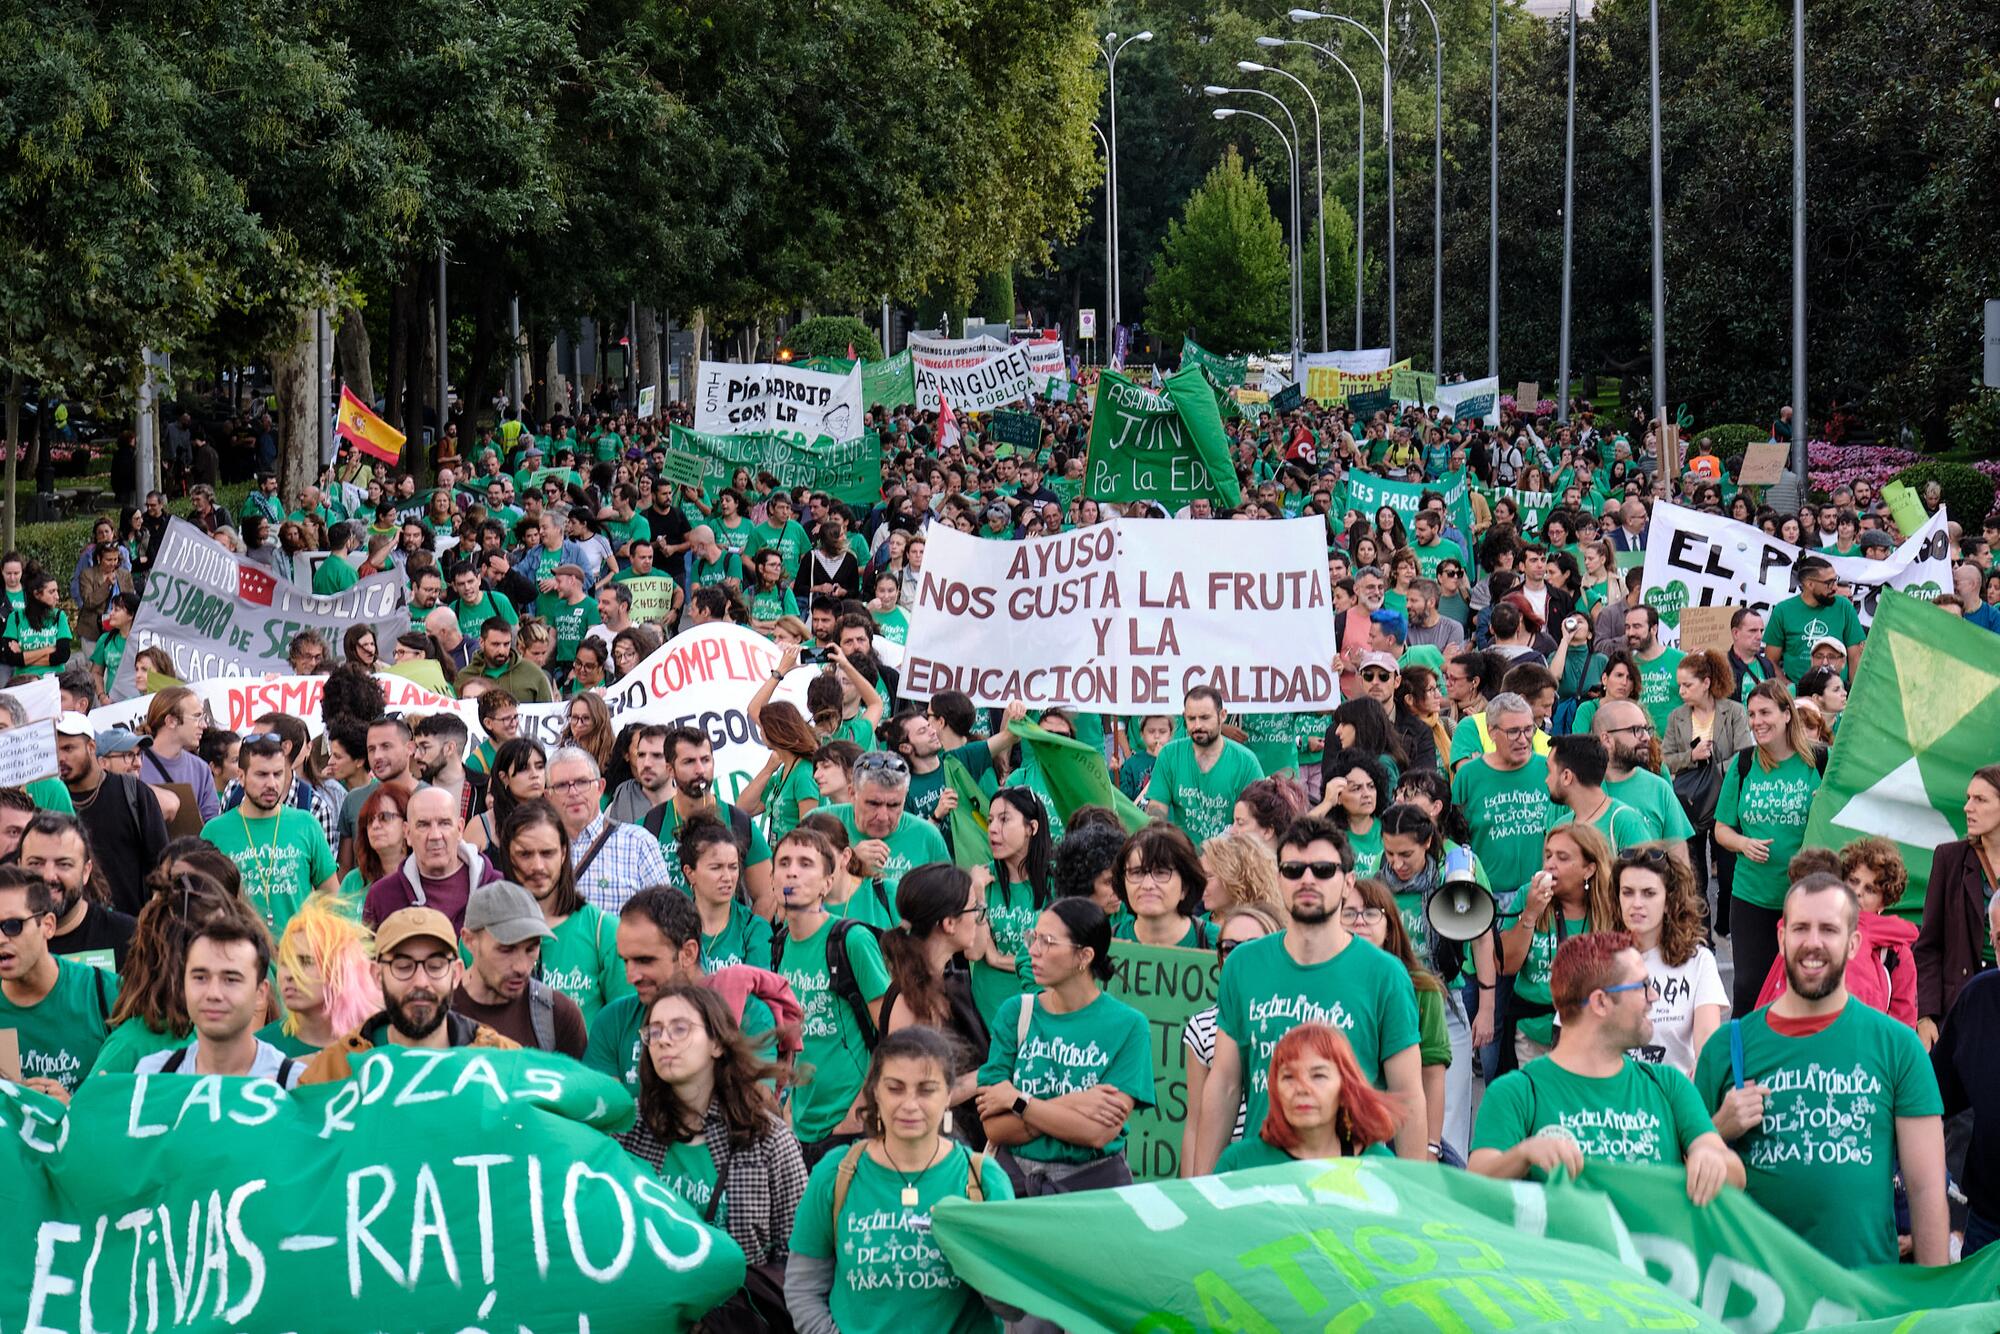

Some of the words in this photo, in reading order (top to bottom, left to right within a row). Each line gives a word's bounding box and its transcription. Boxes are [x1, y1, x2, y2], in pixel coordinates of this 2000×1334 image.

[955, 397, 972, 409] LA
[977, 376, 1036, 408] PÚBLICA
[1309, 367, 1340, 398] IES
[728, 402, 767, 423] CON
[776, 402, 798, 422] LA
[1094, 460, 1121, 495] Por
[1132, 458, 1157, 491] la
[1351, 479, 1374, 502] IES
[161, 530, 238, 594] INSTITUTO
[1005, 527, 1124, 580] AYUSO:
[1667, 528, 1735, 579] EL
[919, 571, 997, 620] NOS
[1008, 570, 1121, 621] GUSTA
[1138, 570, 1190, 610] LA
[1208, 568, 1325, 611] FRUTA
[1648, 589, 1684, 605] ESCUELA
[228, 624, 254, 653] DE
[1091, 617, 1113, 657] Y
[1129, 617, 1181, 656] LA
[905, 655, 1119, 703] EDUCACIÓN
[1131, 665, 1170, 704] DE
[1182, 663, 1332, 704] CALIDAD
[1249, 997, 1301, 1021] ESCUELA
[127, 1073, 290, 1139] LAS
[317, 1049, 567, 1139] ROZAS
[1021, 1078, 1050, 1096] DE
[1762, 1112, 1799, 1134] DE
[1751, 1142, 1801, 1166] PARA
[345, 1153, 713, 1300] RATIOS
[847, 1209, 909, 1233] ESCUELA
[857, 1247, 891, 1265] DE
[849, 1271, 894, 1292] PARA
